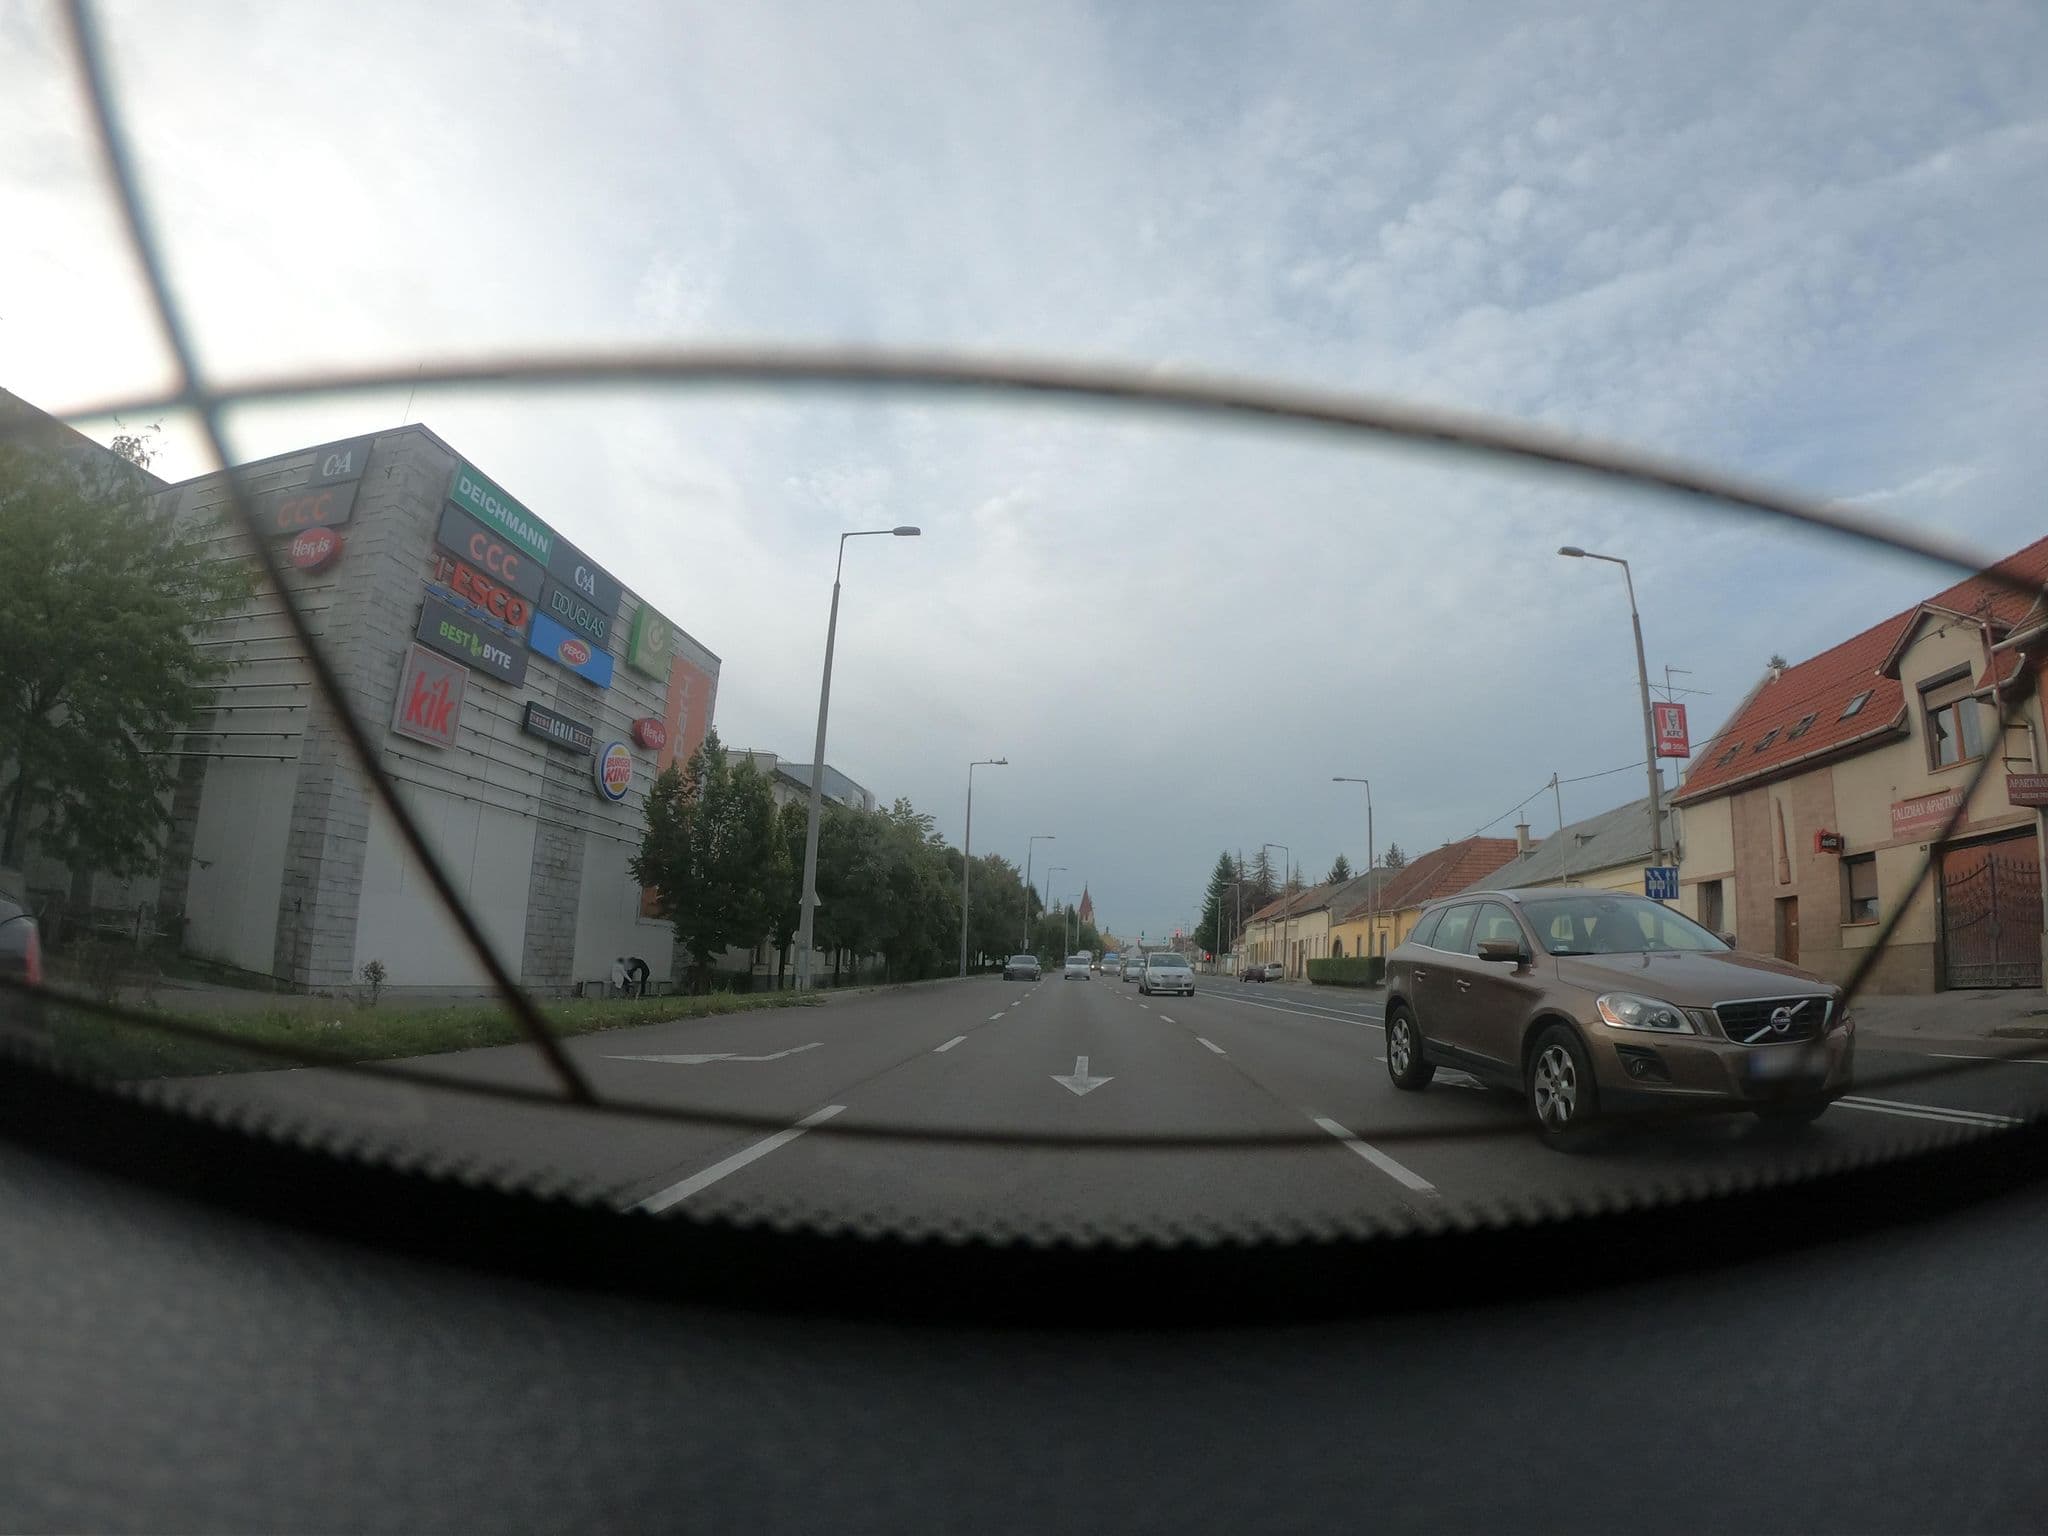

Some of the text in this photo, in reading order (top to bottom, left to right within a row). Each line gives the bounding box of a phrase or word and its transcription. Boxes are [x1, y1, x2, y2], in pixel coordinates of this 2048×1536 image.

[321, 451, 352, 477] C&A
[278, 492, 333, 529] CCC
[459, 476, 549, 553] DEICHMANN
[469, 532, 519, 581] CCC
[574, 565, 595, 597] C&A
[551, 590, 606, 638] DOUGLAS
[440, 620, 512, 670] BEST BYTE
[548, 718, 574, 743] AGRIA
[605, 766, 631, 784] KING
[606, 757, 631, 768] BURGER
